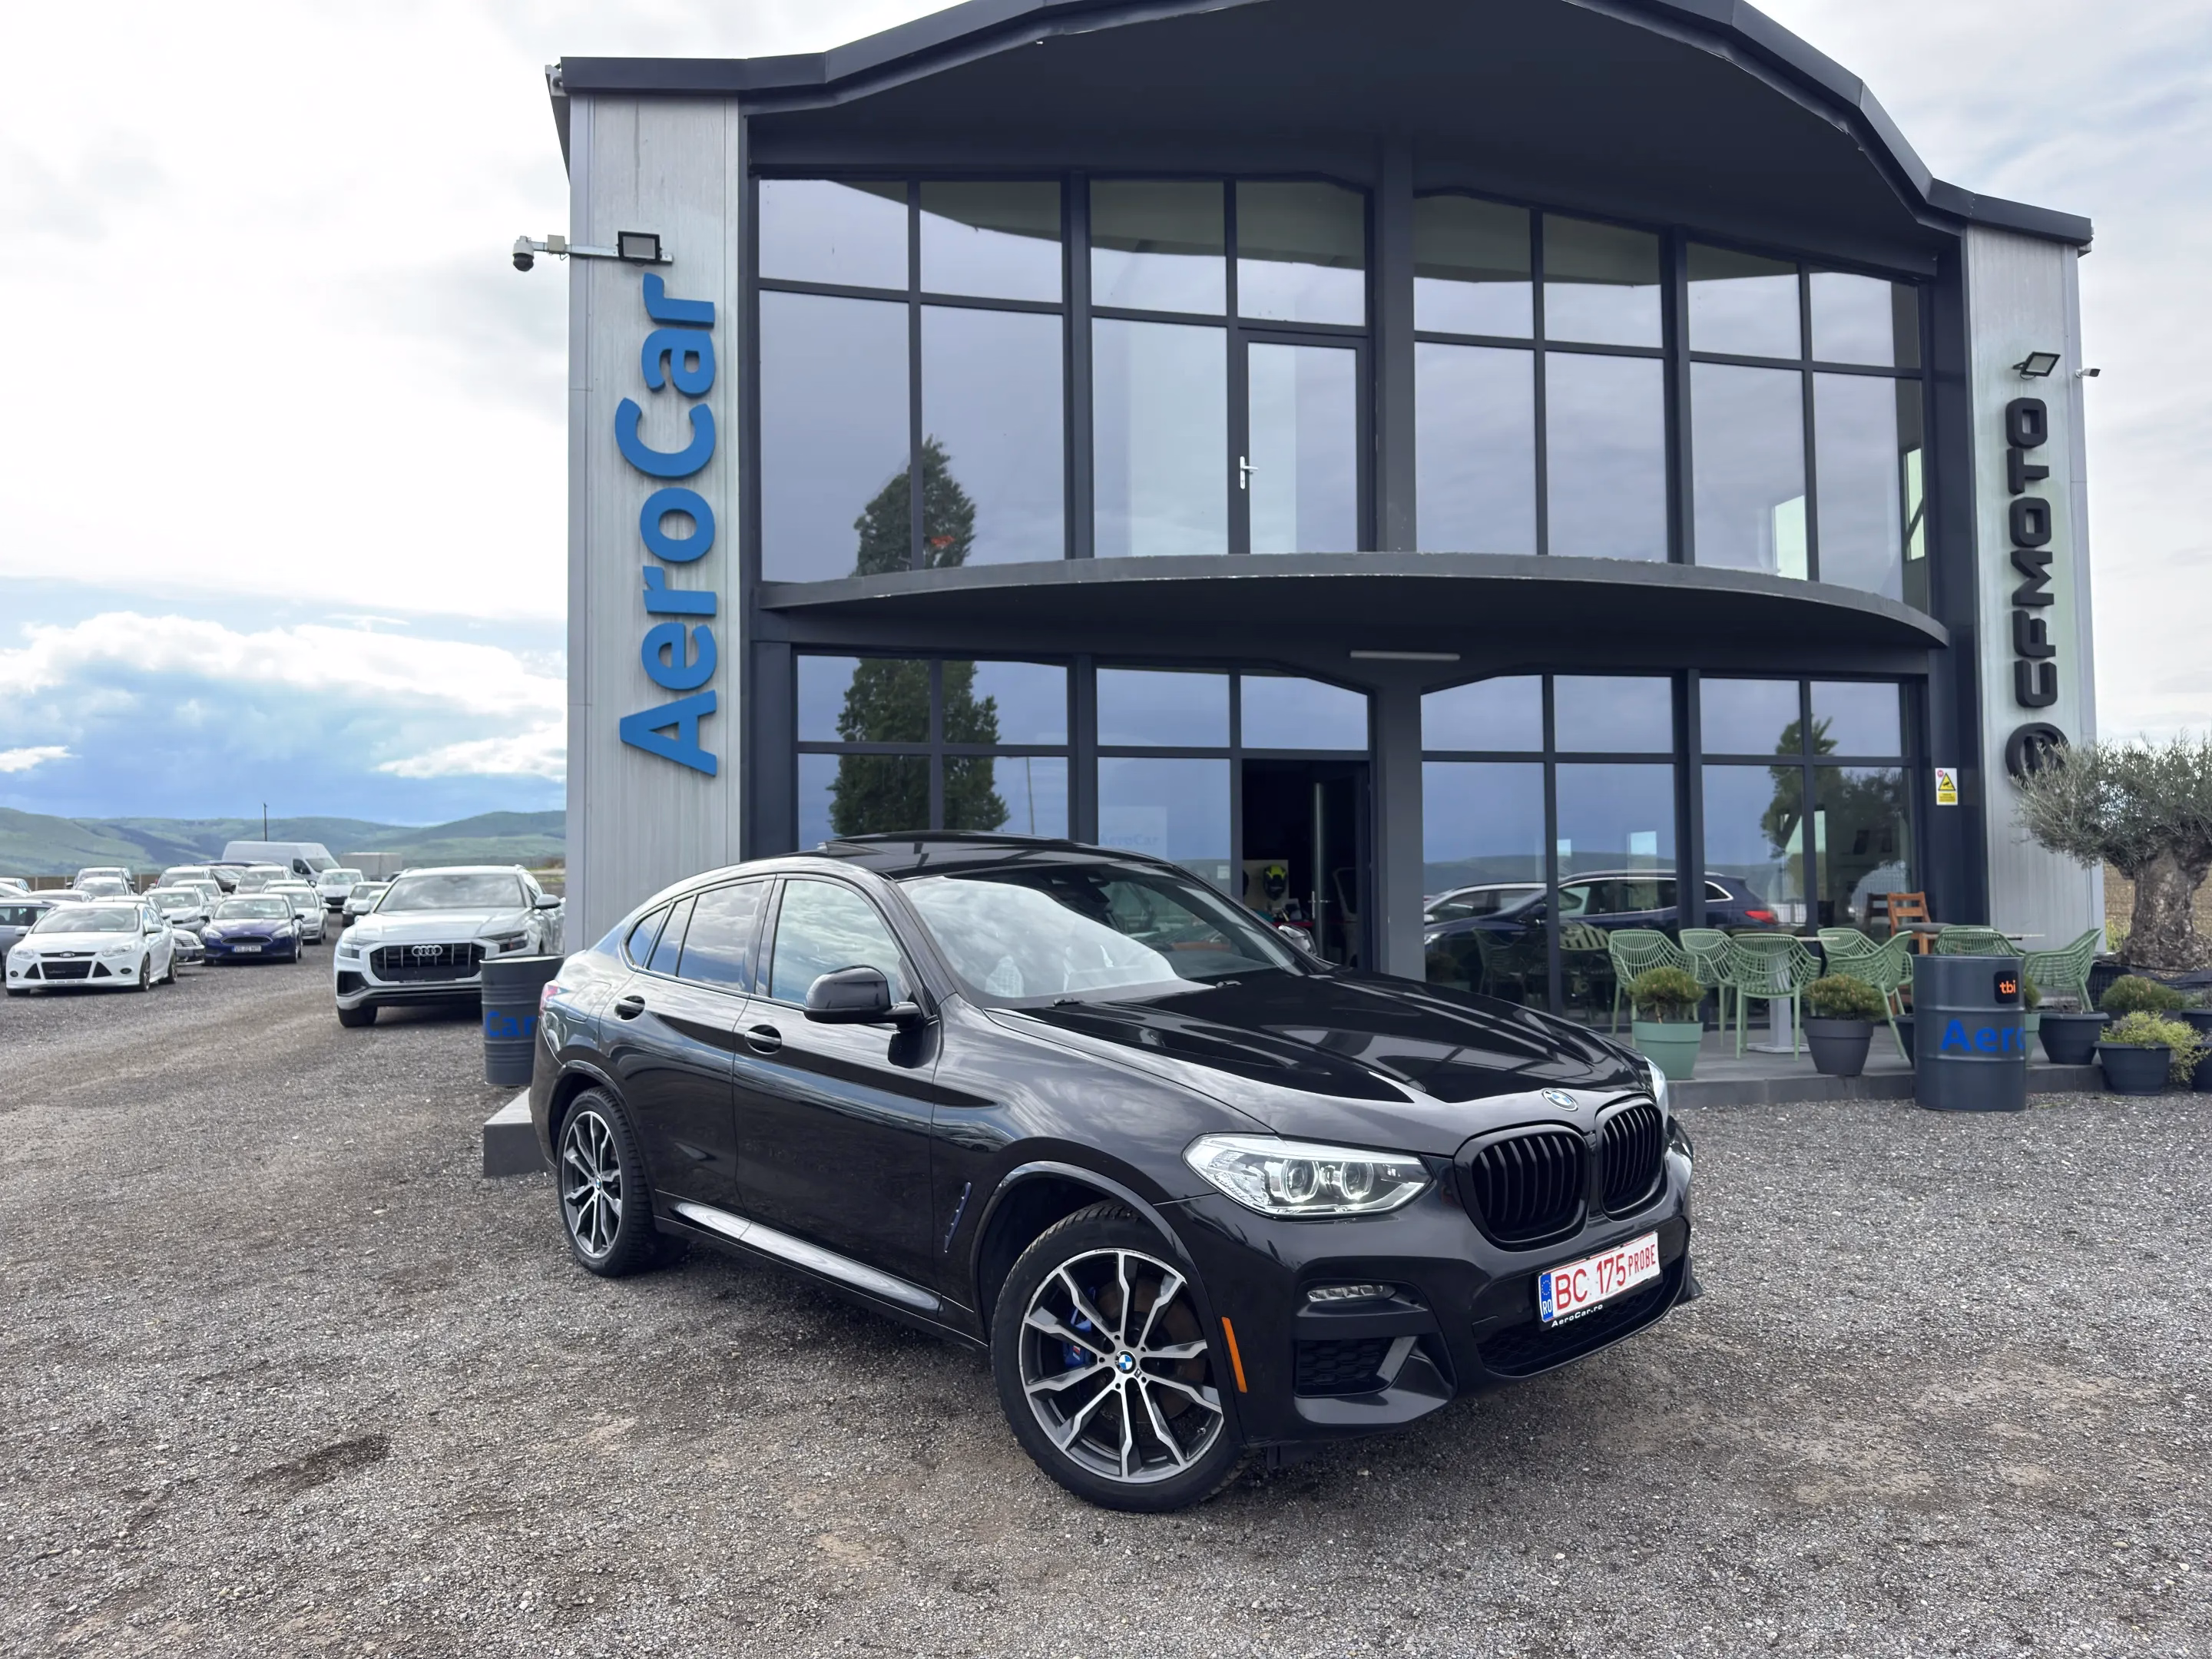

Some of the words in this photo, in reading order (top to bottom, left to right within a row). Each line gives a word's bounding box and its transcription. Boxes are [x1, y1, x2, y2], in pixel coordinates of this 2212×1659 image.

[614, 272, 717, 777] AeroCar
[2005, 397, 2058, 707] CFMOTO
[1999, 980, 2016, 994] tbi
[1555, 1268, 1588, 1310] BC
[1597, 1253, 1626, 1294] 175
[1628, 1244, 1656, 1276] PROBE
[1542, 1299, 1552, 1315] RO
[1551, 1304, 1603, 1327] AeroCar.ro
